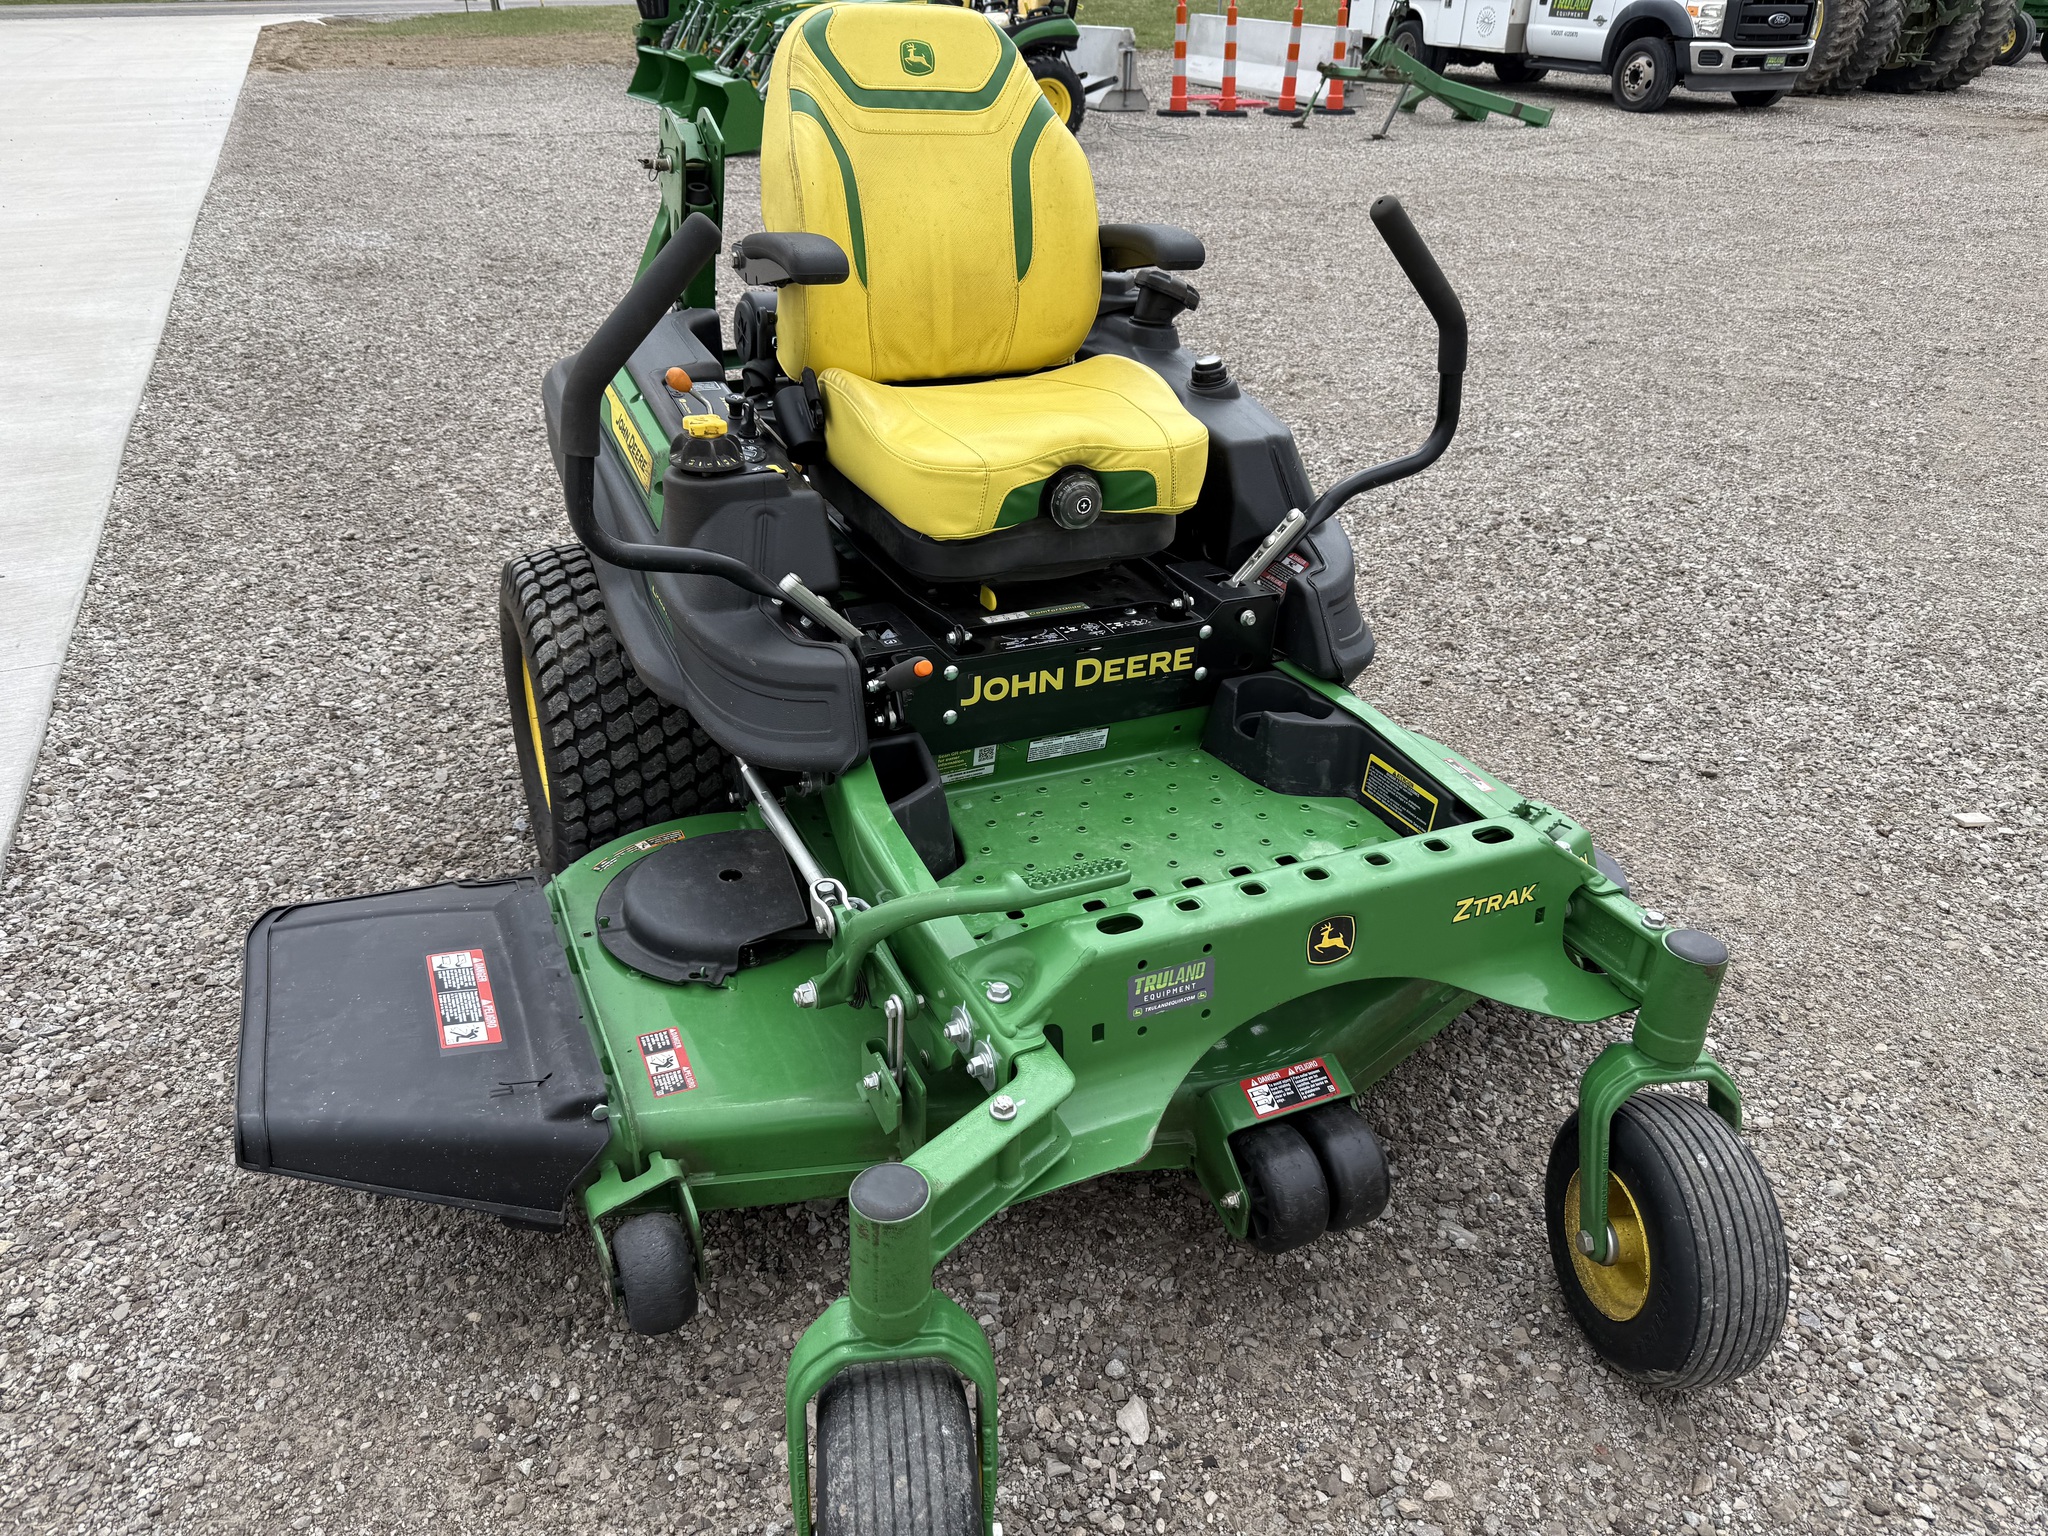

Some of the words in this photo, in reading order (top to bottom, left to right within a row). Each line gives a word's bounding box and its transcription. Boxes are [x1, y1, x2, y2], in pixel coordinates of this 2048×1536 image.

[1556, 10, 1584, 18] EQUIPMENT
[615, 413, 630, 440] JOHN
[628, 433, 648, 473] DEERE
[960, 667, 1064, 707] JOHN
[1075, 646, 1195, 688] DEERE
[1452, 882, 1539, 923] ZTRAK
[473, 962, 488, 983] DANGER
[1134, 961, 1206, 995] TRULAND
[1143, 982, 1197, 1002] EQUIPMENT
[483, 1004, 498, 1028] PELIGRO
[1256, 1071, 1281, 1084] DANGER
[1293, 1060, 1319, 1073] PELIGRO
